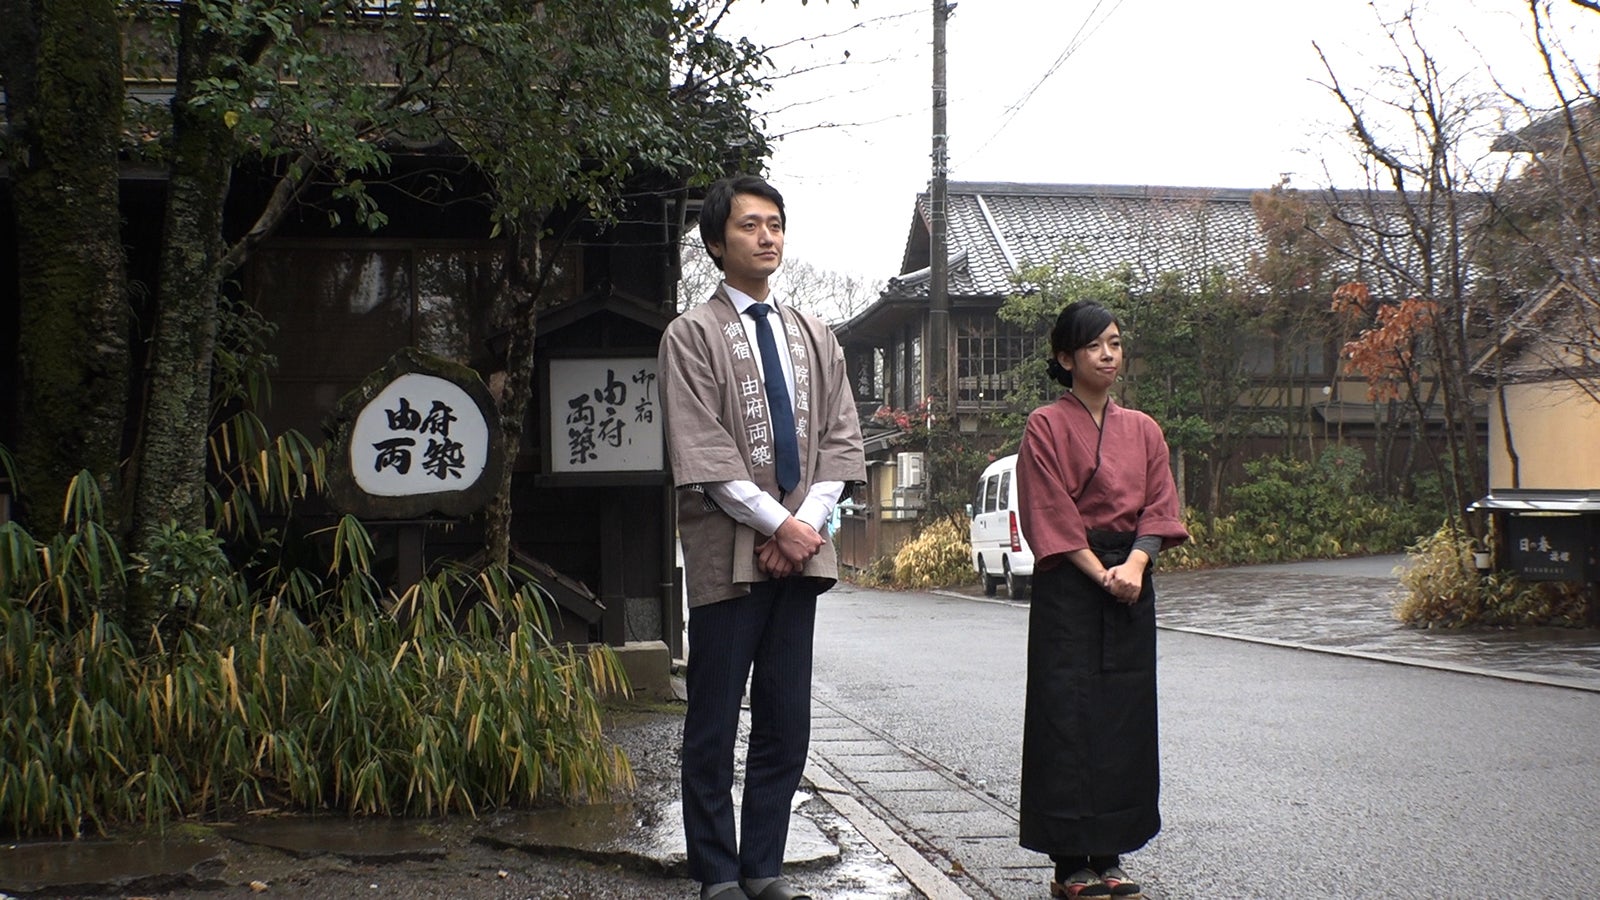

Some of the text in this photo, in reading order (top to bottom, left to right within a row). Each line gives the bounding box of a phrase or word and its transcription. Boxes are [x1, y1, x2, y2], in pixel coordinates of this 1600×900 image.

[385, 397, 458, 437] 由府
[594, 369, 627, 448] 由府
[723, 321, 773, 468] 御宿 由府両築
[785, 322, 810, 438] 由布院温泉
[372, 437, 466, 480] 両築
[566, 394, 598, 465] 両築
